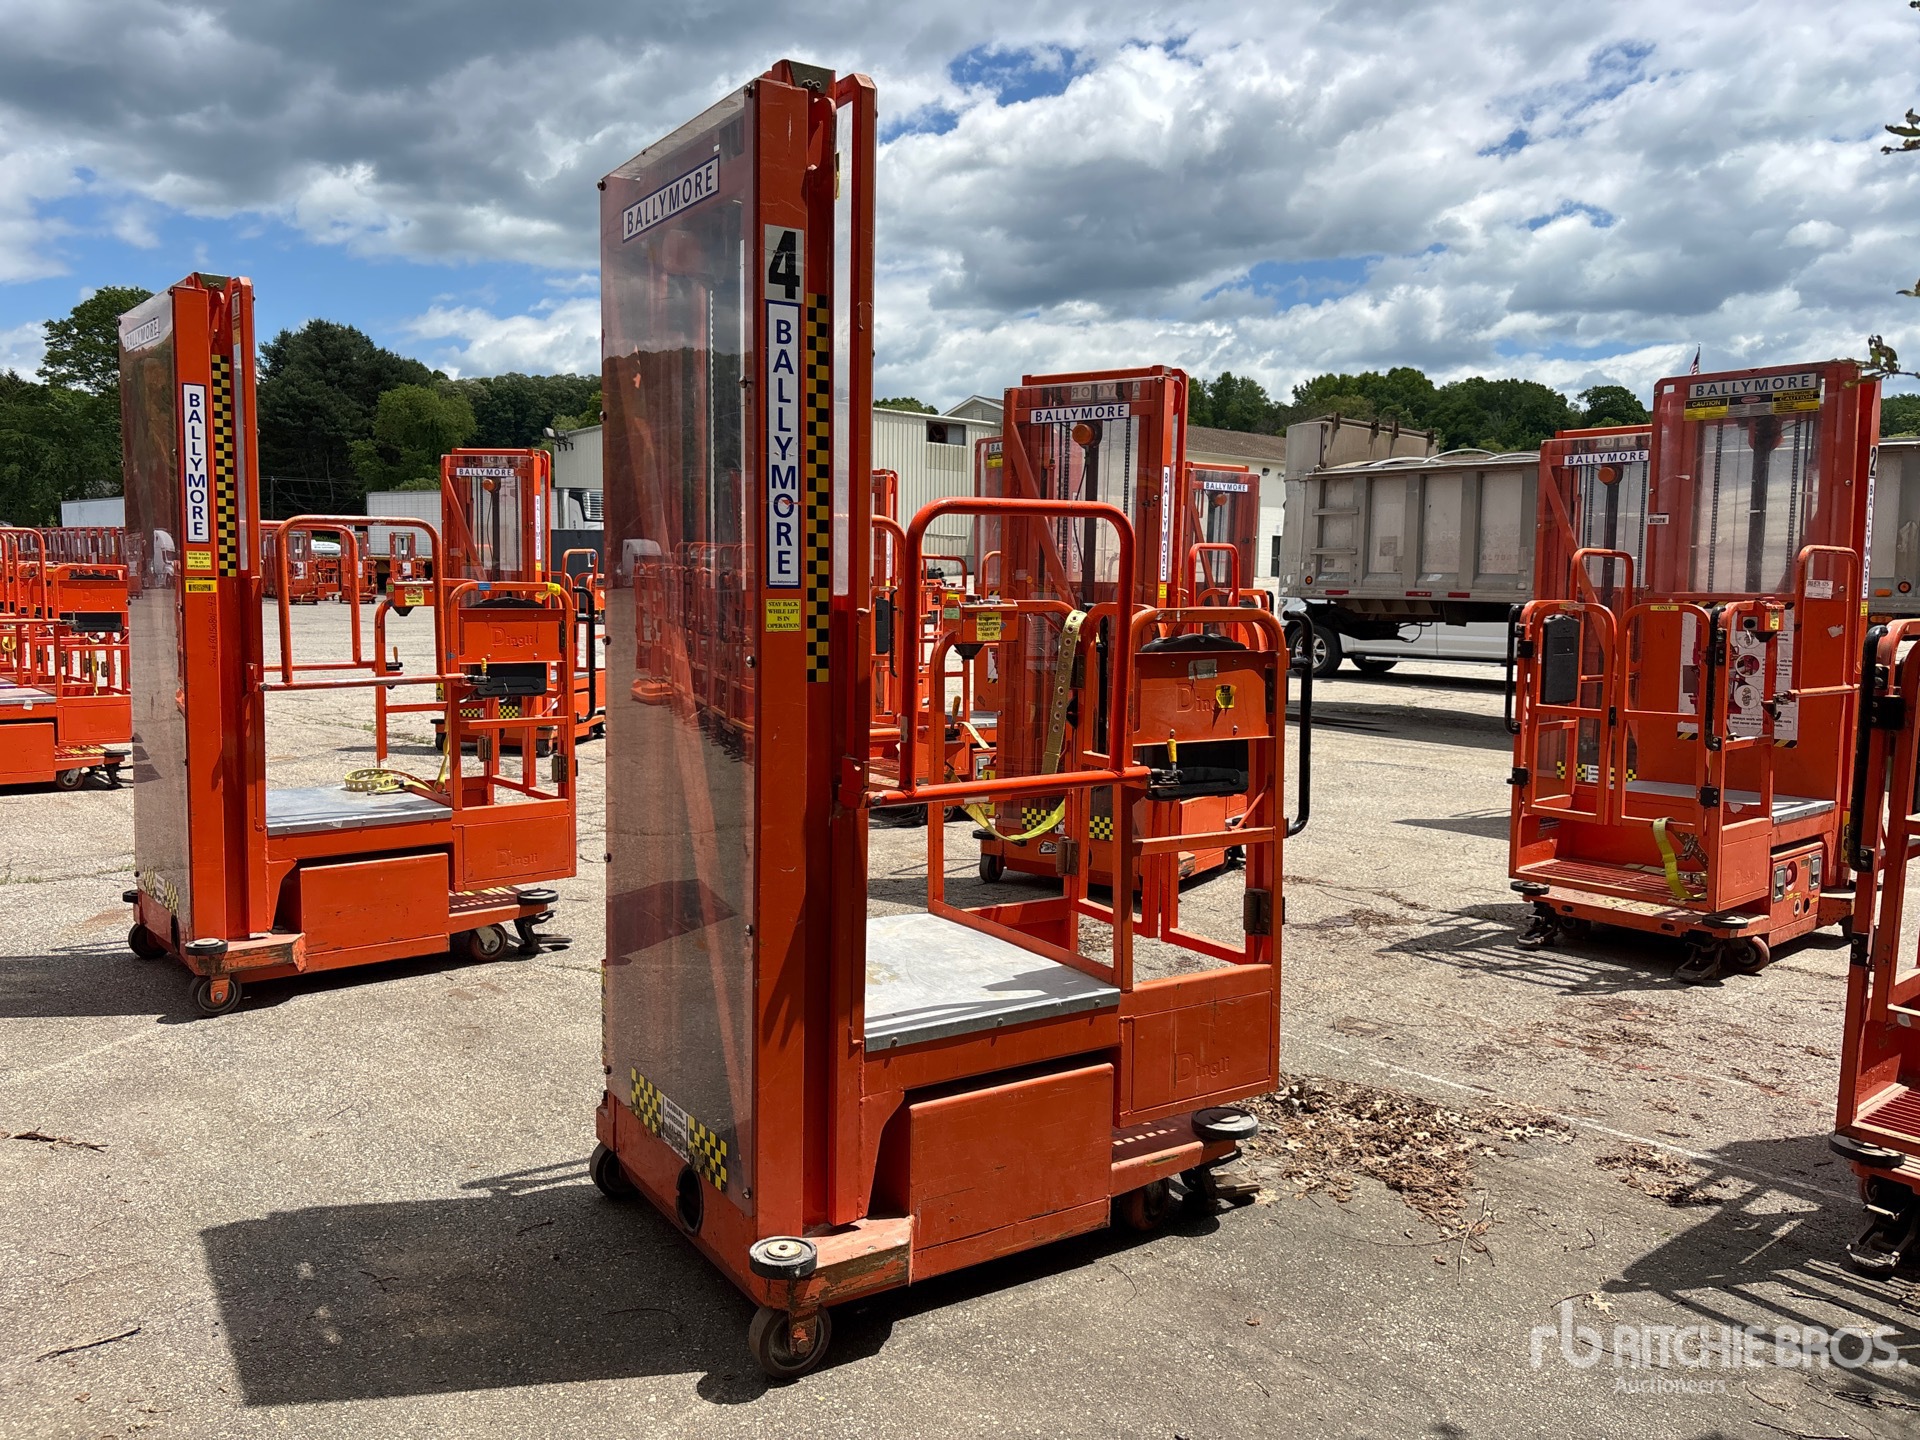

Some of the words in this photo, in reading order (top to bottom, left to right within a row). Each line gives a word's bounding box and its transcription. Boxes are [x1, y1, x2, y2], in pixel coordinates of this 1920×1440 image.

[627, 165, 712, 235] BALLYMORE
[768, 230, 800, 300] 4
[126, 320, 157, 350] BALLYMORE
[1696, 376, 1809, 396] BALLYMORE
[1036, 406, 1124, 422] BALLYMORE
[771, 318, 796, 574] BALLYMORE
[1568, 452, 1644, 464] BALLYMORE
[1870, 446, 1876, 476] 2
[188, 393, 206, 536] BALLYMORE
[1206, 482, 1246, 491] BALLYMORE
[1864, 485, 1873, 594] BALLYMORE
[491, 627, 533, 648] Dingli
[497, 849, 538, 867] Dingli
[1177, 1052, 1229, 1082] Dingli
